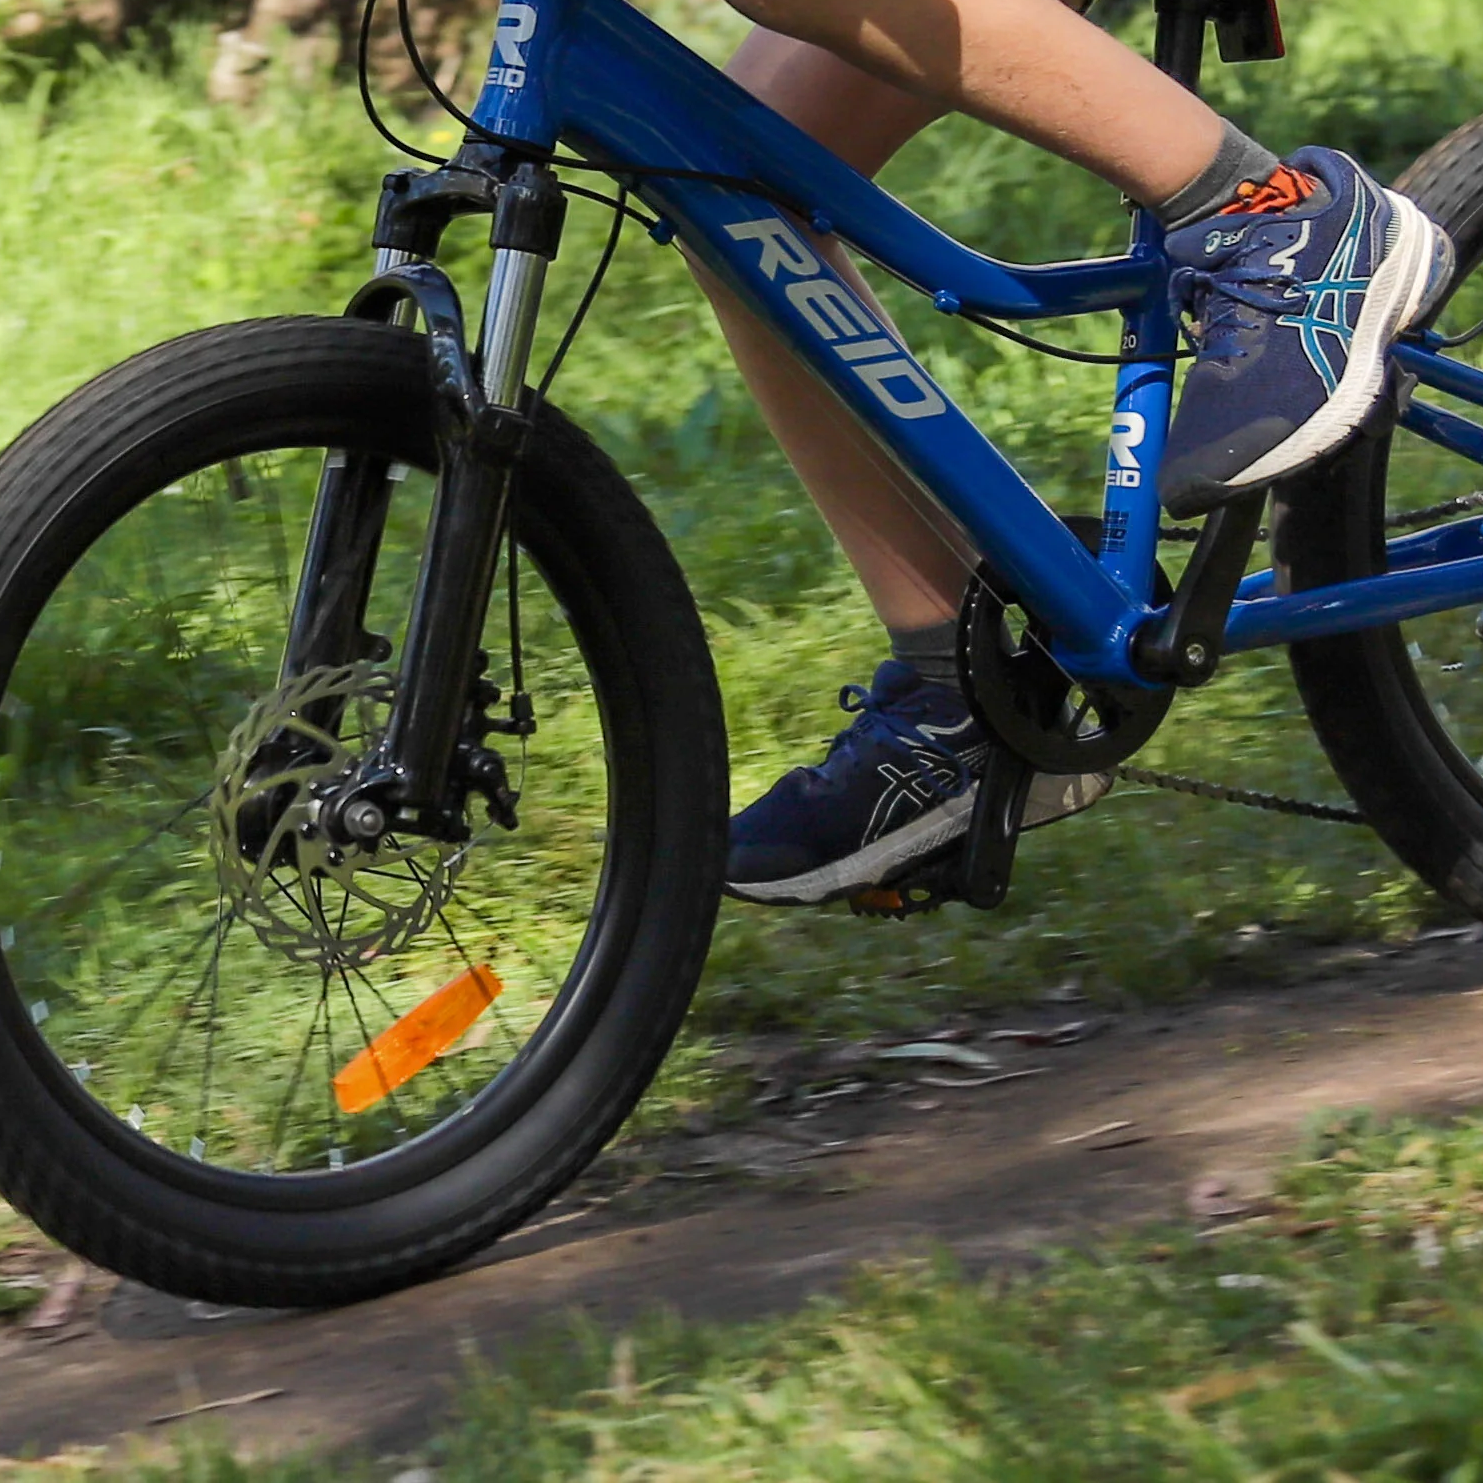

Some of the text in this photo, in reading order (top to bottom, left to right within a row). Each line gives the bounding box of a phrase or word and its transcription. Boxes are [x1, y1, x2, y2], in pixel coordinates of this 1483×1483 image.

[494, 3, 537, 67] R
[723, 218, 946, 419] REID
[1111, 411, 1146, 468] R
